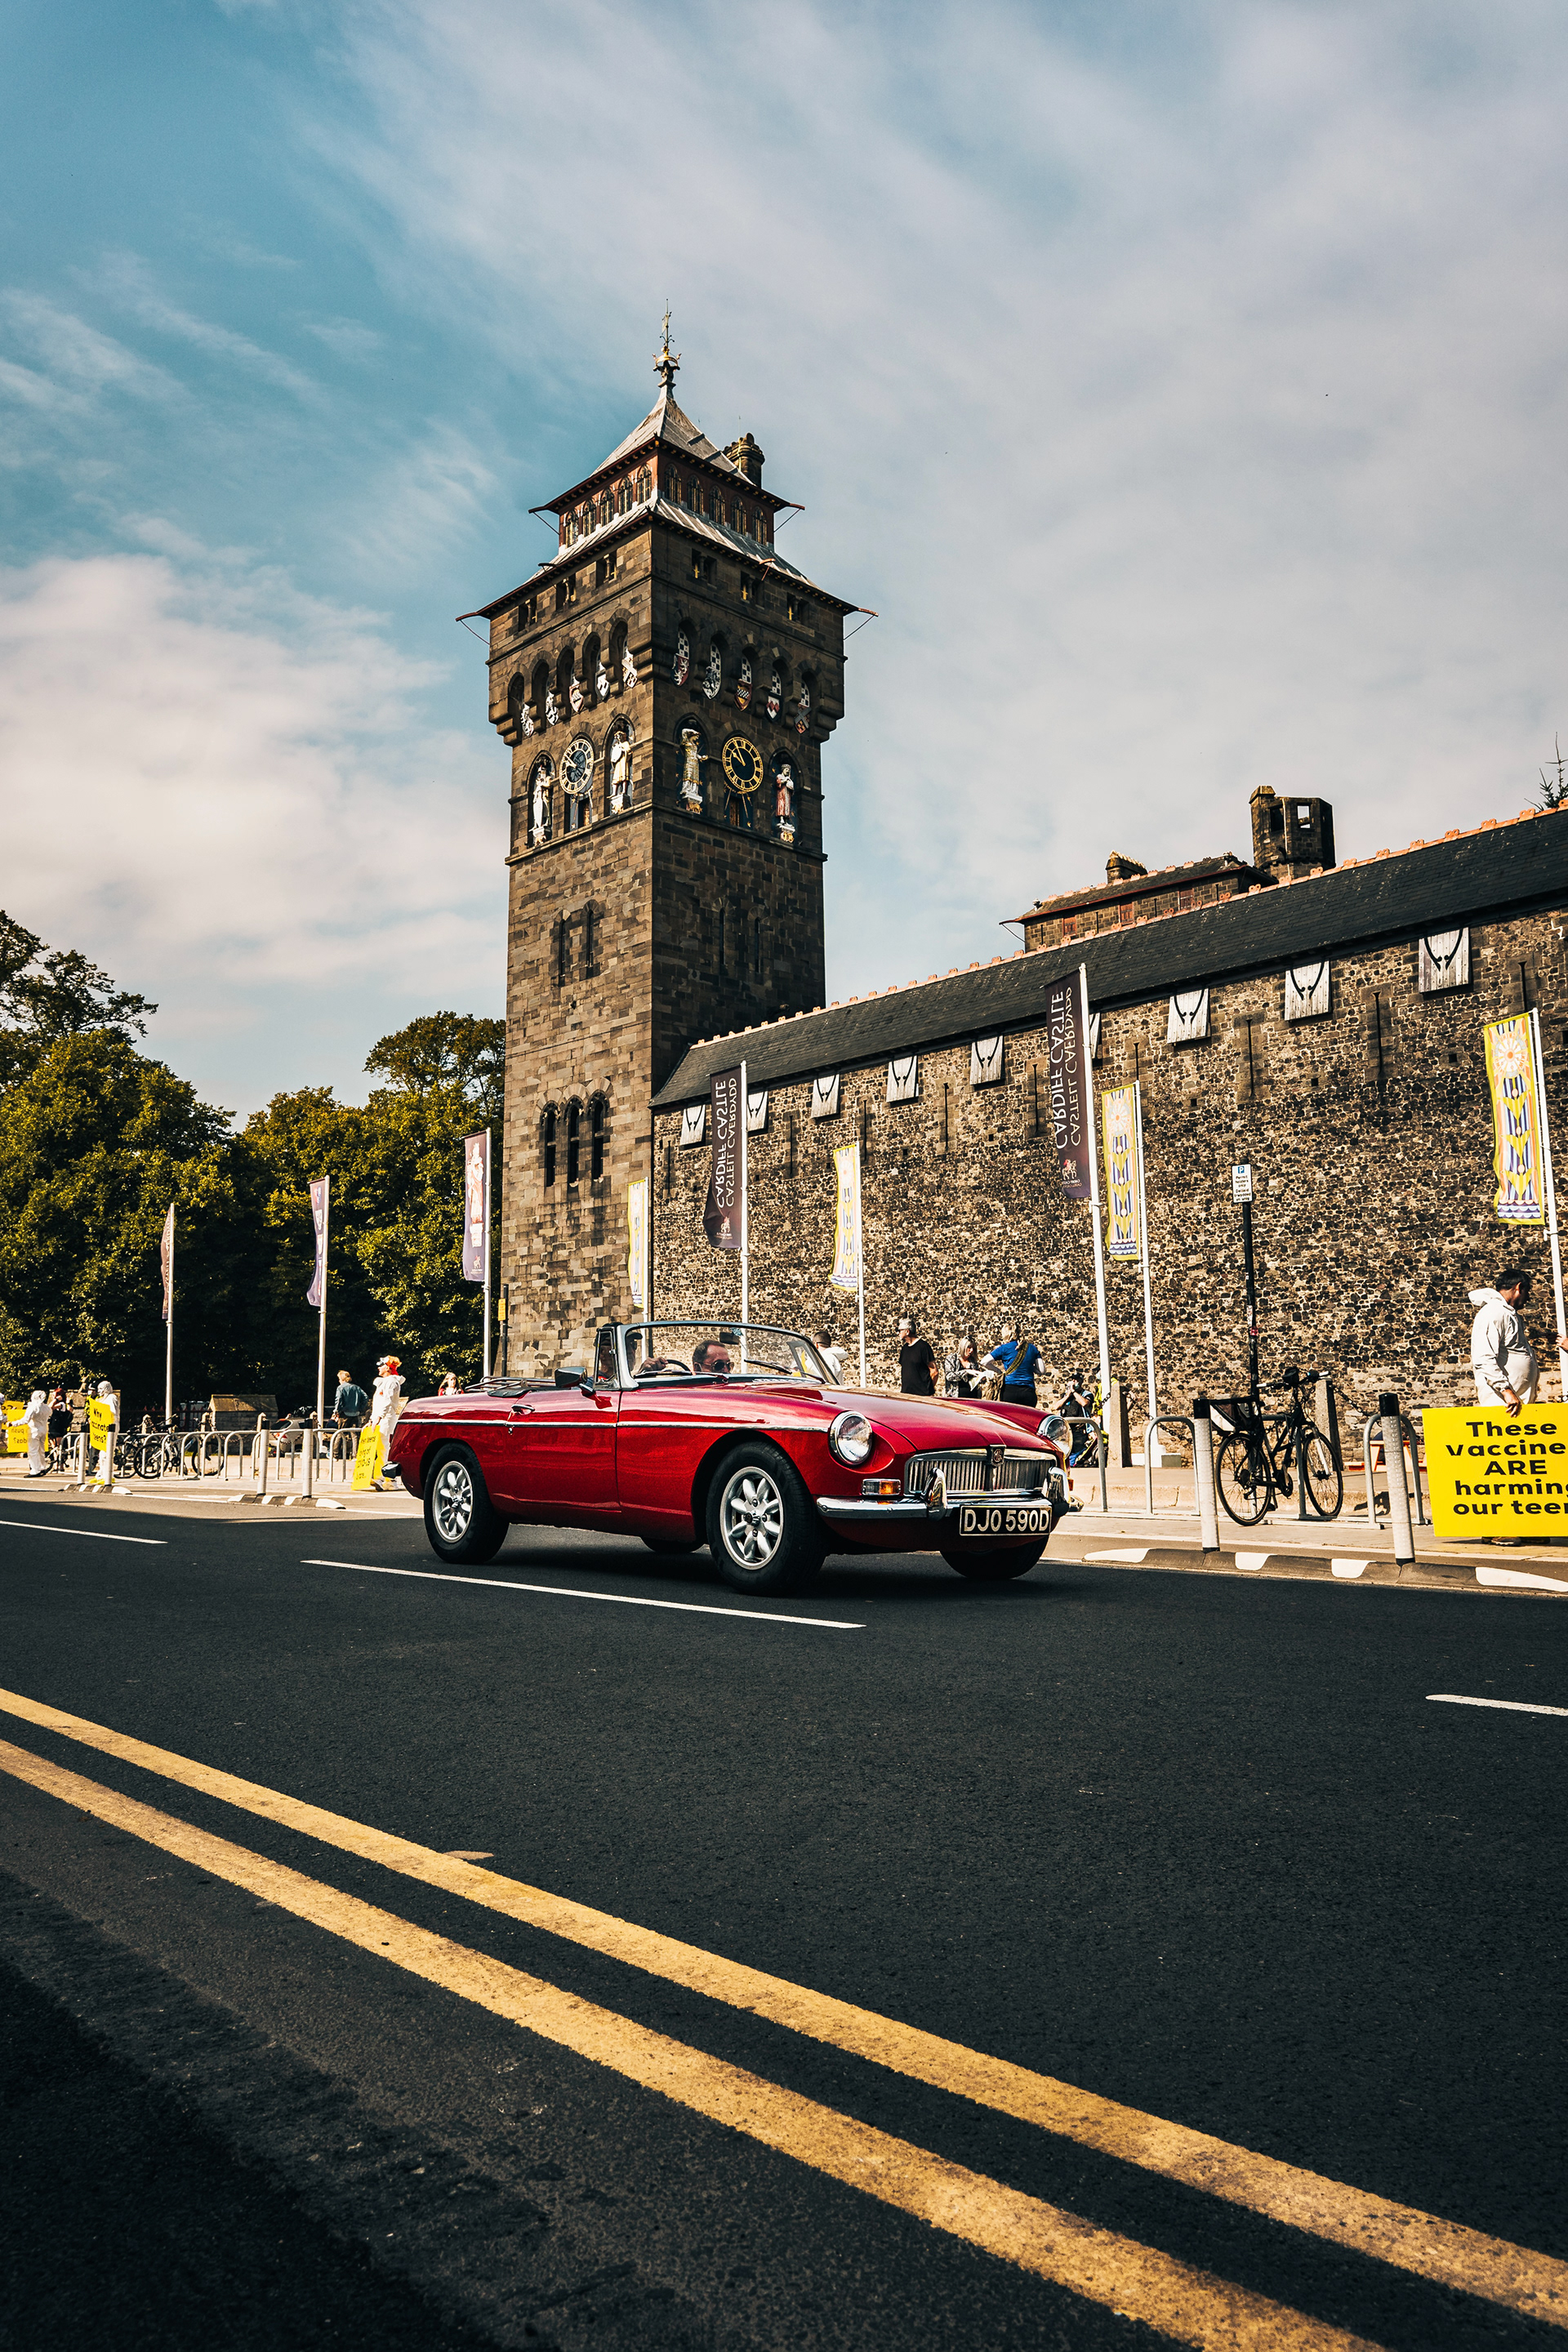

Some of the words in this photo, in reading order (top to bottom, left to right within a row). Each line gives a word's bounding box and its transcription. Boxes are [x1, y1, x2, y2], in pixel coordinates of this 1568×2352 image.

[1466, 1421, 1557, 1437] These
[1446, 1439, 1566, 1456] vaccine
[1484, 1459, 1548, 1476] ARE
[1454, 1478, 1568, 1498] harmin
[1453, 1503, 1503, 1515] our
[1511, 1500, 1568, 1515] tee
[964, 1509, 1002, 1532] DJO
[1005, 1509, 1049, 1532] 590D
